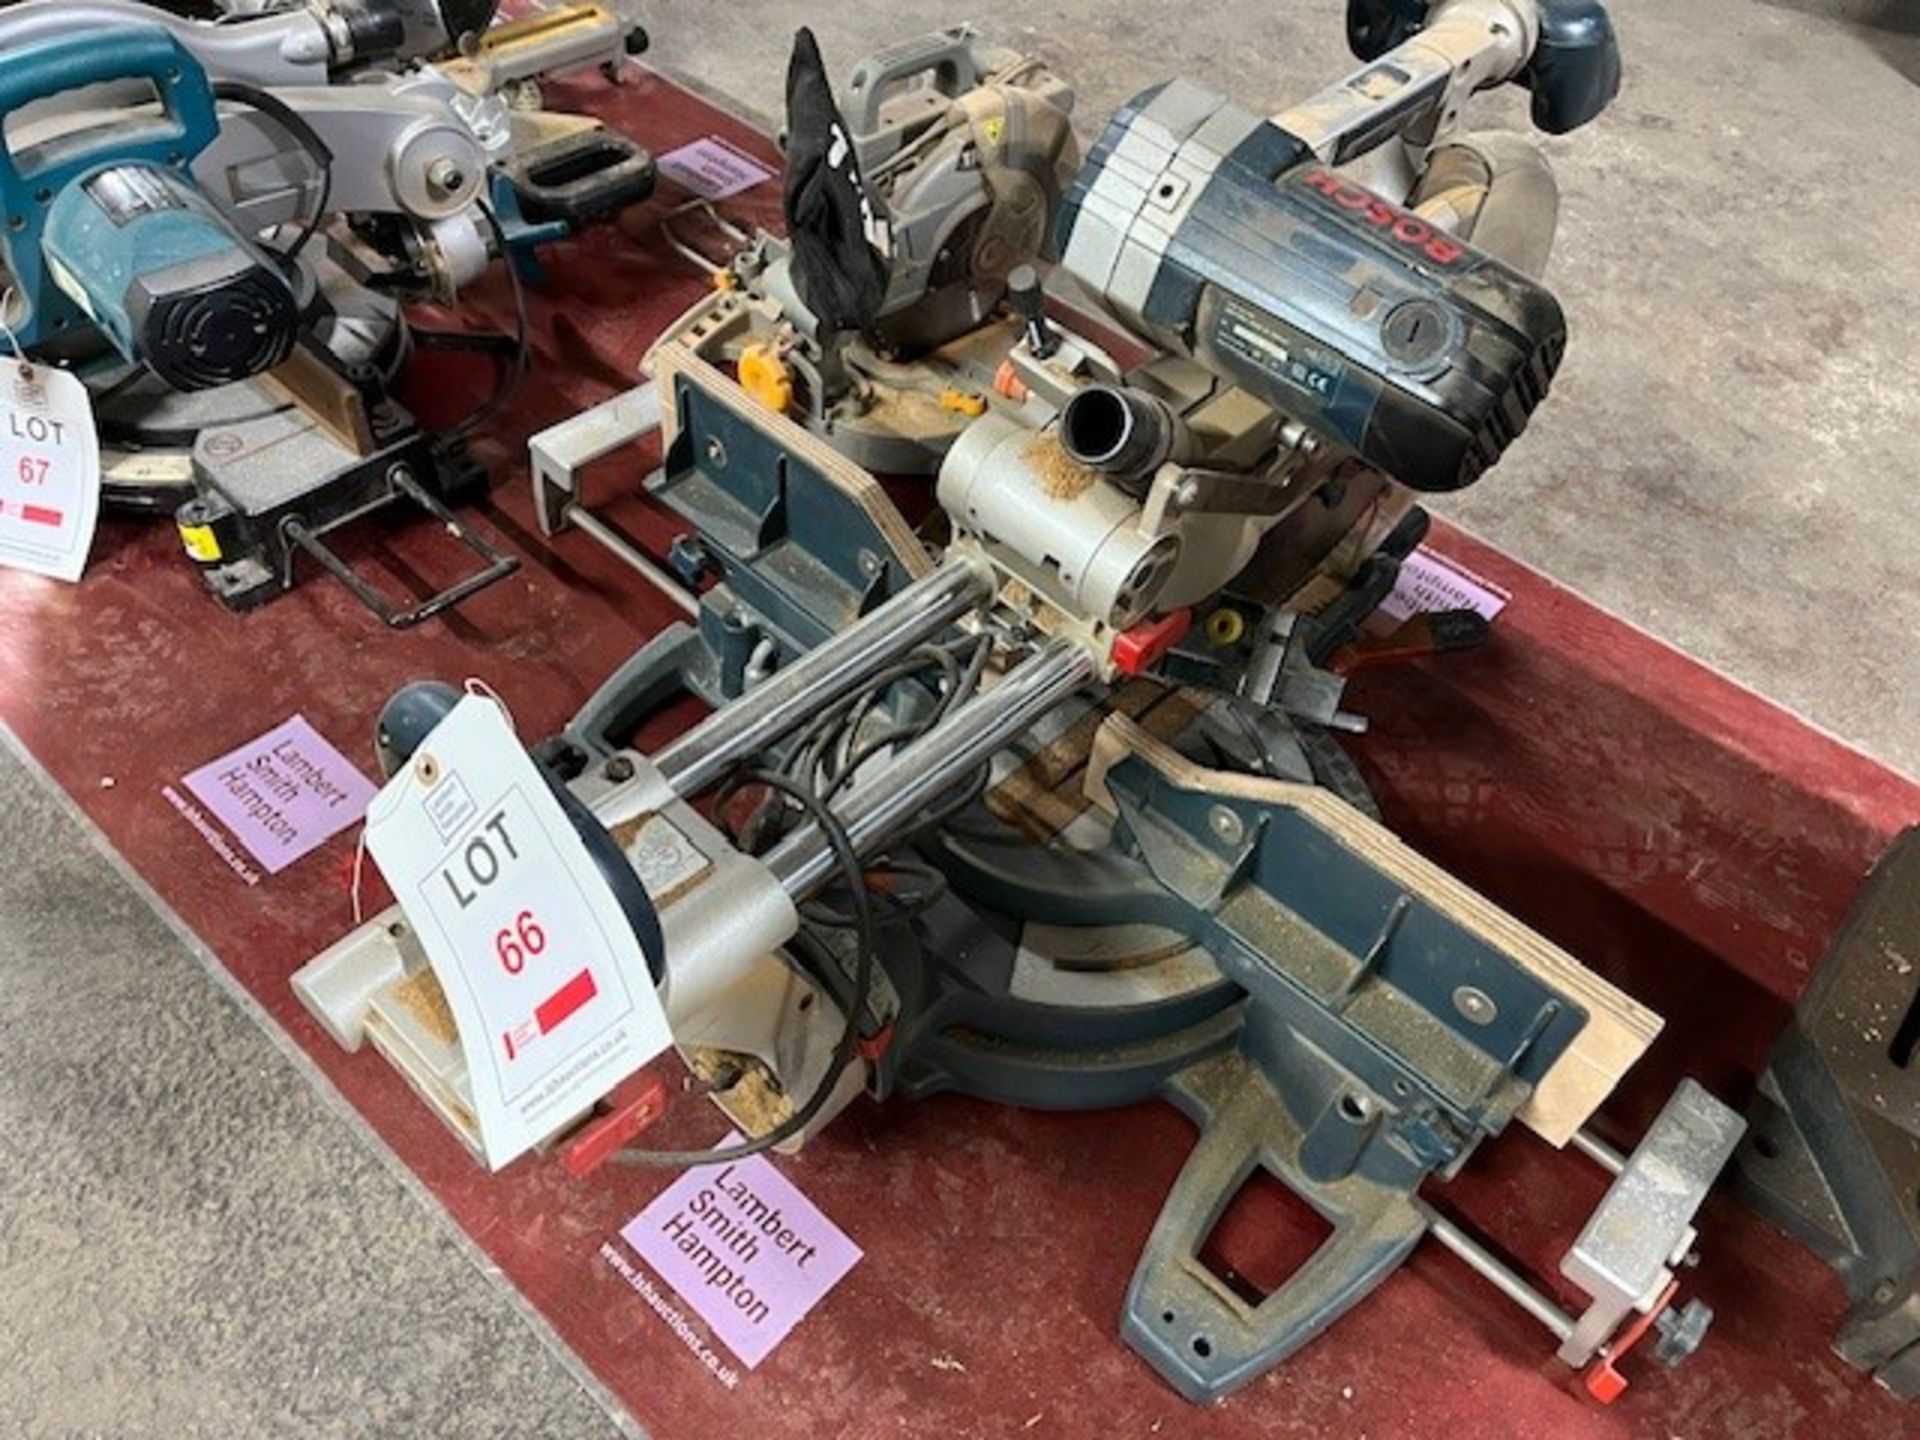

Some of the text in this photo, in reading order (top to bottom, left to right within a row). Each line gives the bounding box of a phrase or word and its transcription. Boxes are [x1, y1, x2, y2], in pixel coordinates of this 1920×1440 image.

[1305, 171, 1464, 265] BOSCH
[9, 412, 63, 446] LOT
[19, 456, 50, 485] 67
[218, 767, 298, 846] Hampton
[246, 755, 299, 804] Smith
[272, 739, 348, 808] Lambert
[443, 809, 518, 910] LOT
[496, 910, 545, 975] 66
[688, 1189, 760, 1264] Smith
[714, 1165, 816, 1269] Lambert
[662, 1211, 769, 1324] Hampton
[600, 1241, 739, 1390] www.lshauctions.co.uk
